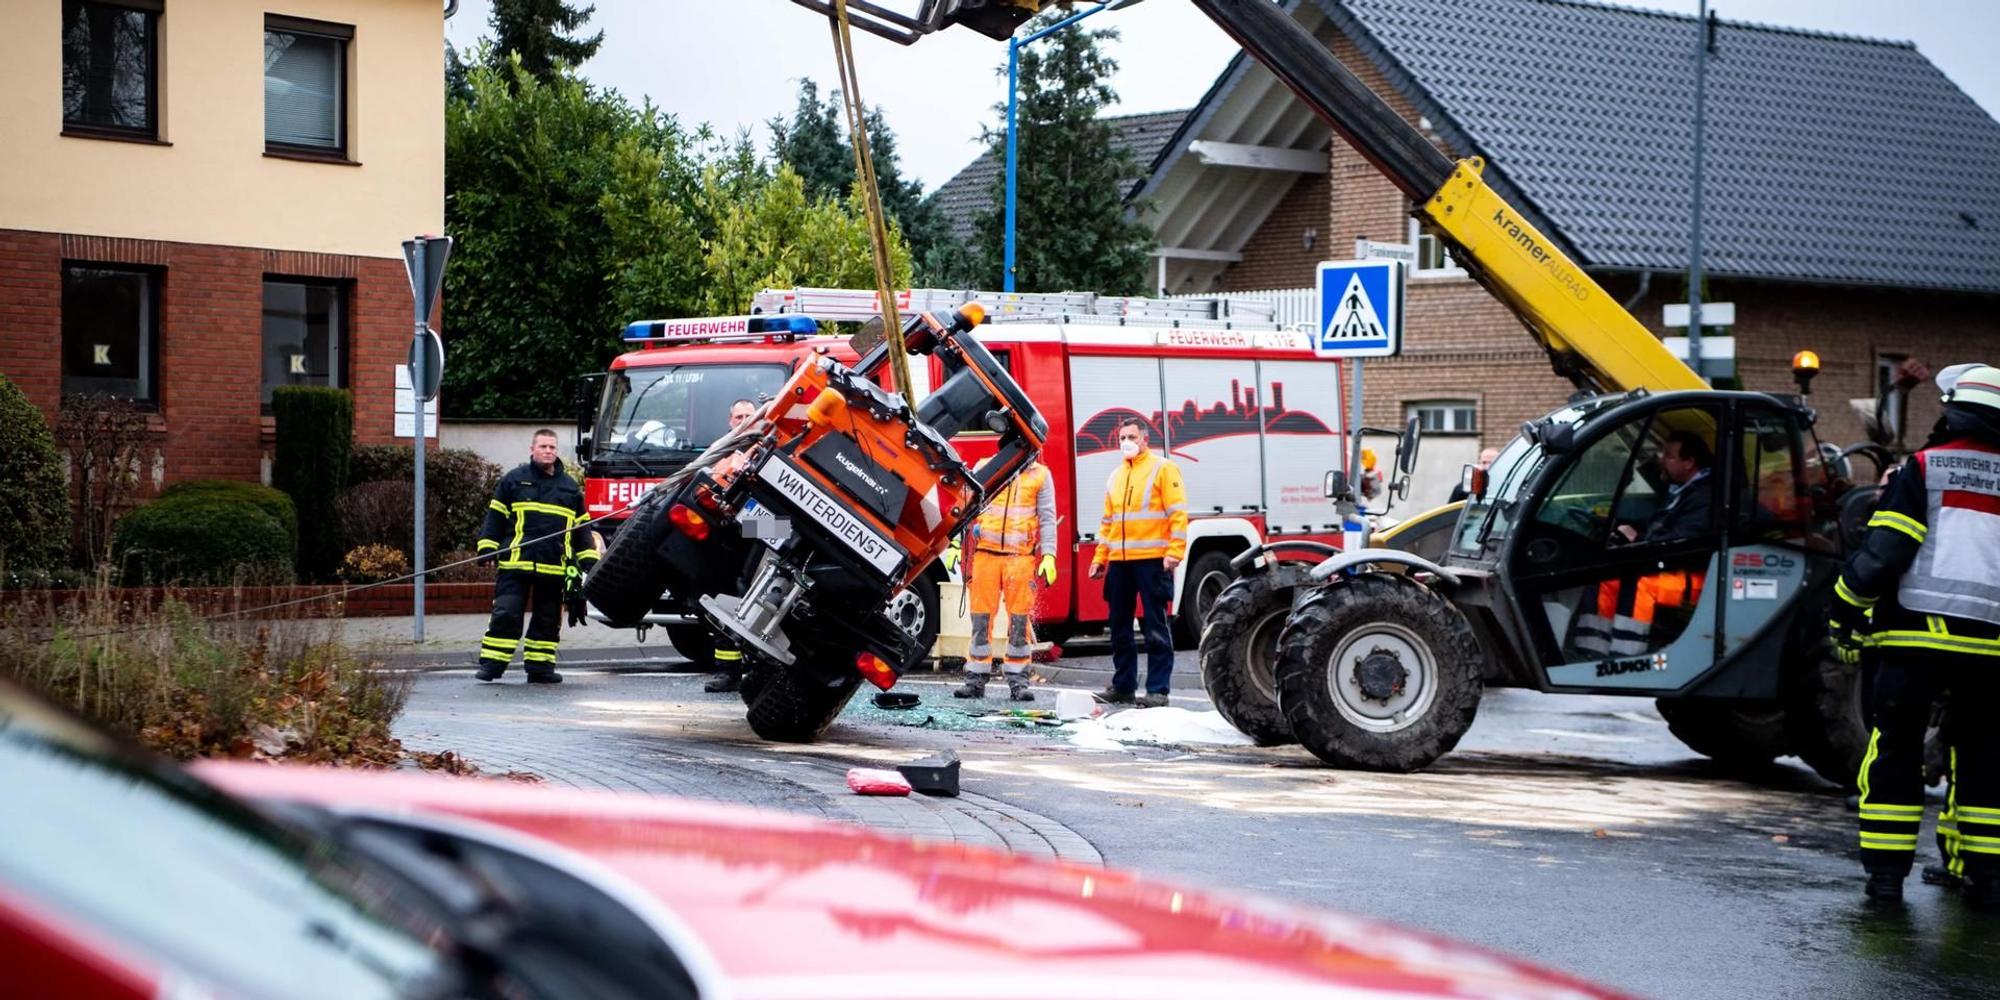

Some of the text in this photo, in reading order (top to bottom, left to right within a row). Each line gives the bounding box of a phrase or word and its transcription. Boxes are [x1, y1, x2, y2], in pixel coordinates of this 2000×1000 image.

[667, 320, 746, 337] FEUERWEHR
[1169, 330, 1246, 346] FEUERWEHR
[93, 344, 111, 365] K
[290, 354, 306, 374] K
[835, 452, 885, 495] kugelmann
[1929, 455, 1992, 473] FEUERWEHR
[1948, 471, 1995, 489] Zugführer
[776, 469, 888, 560] WINTERDIENST
